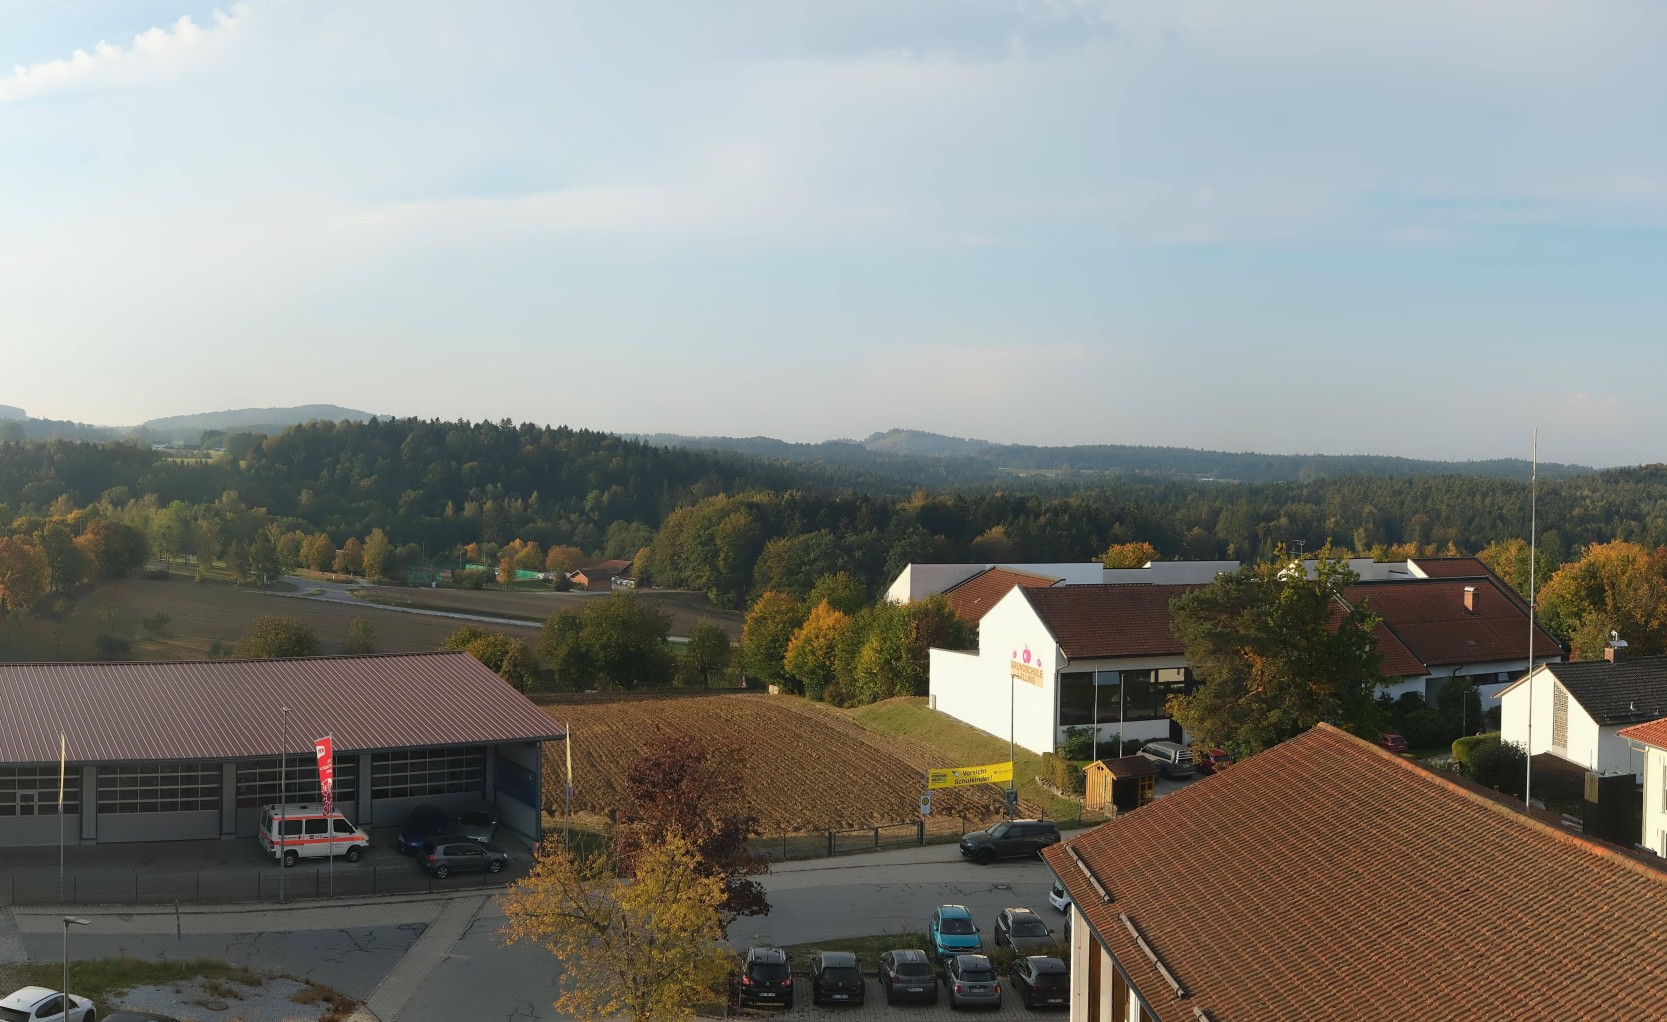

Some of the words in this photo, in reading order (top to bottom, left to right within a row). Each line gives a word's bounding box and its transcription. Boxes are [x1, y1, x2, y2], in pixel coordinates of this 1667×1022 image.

[1011, 661, 1043, 678] GRUNDSCHULE
[1018, 672, 1035, 684] LALLING
[954, 775, 992, 784] Schulkinder!
